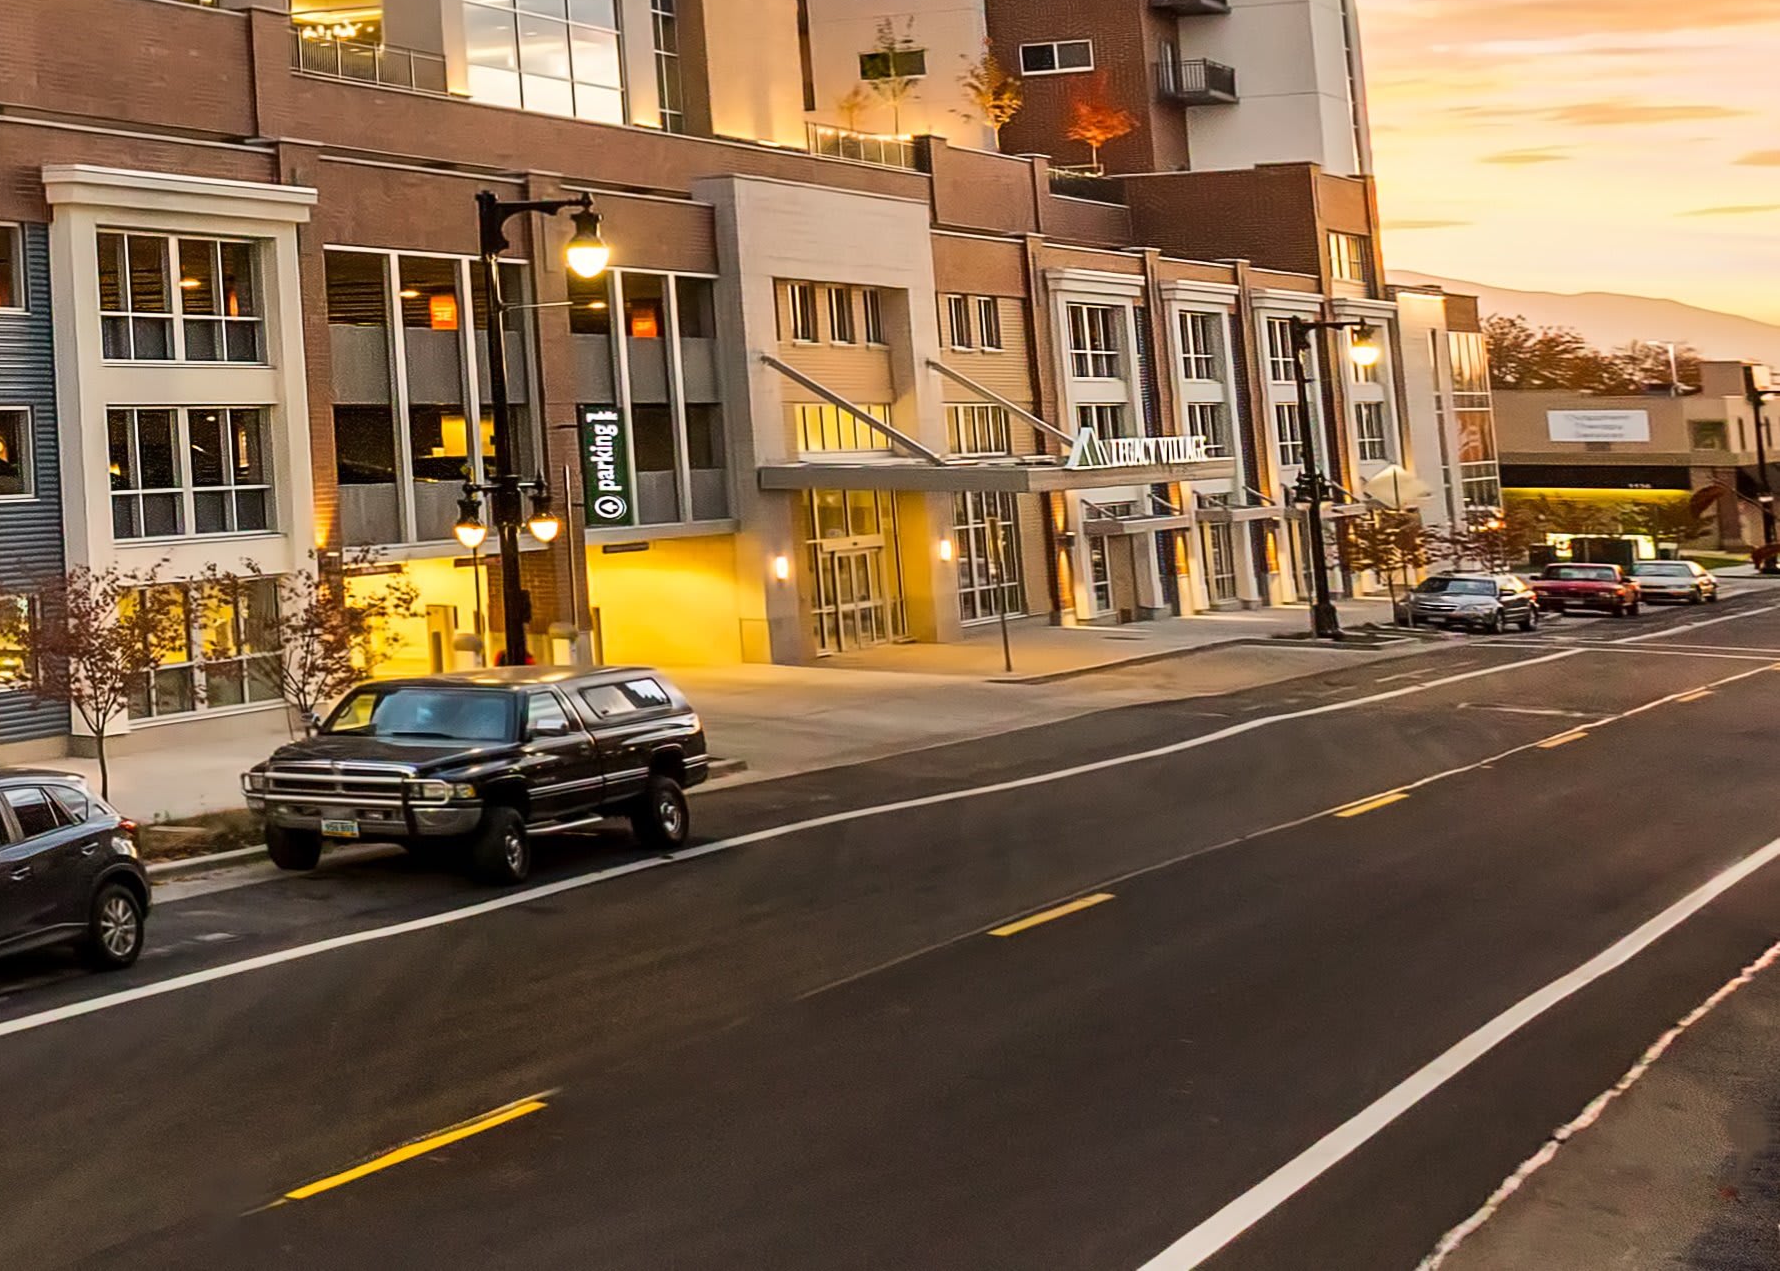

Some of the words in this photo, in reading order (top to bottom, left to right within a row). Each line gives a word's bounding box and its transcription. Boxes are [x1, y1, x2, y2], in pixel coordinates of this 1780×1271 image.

[589, 424, 623, 491] parking
[1110, 436, 1158, 466] LEGACY
[1158, 434, 1208, 464] VILLAGE
